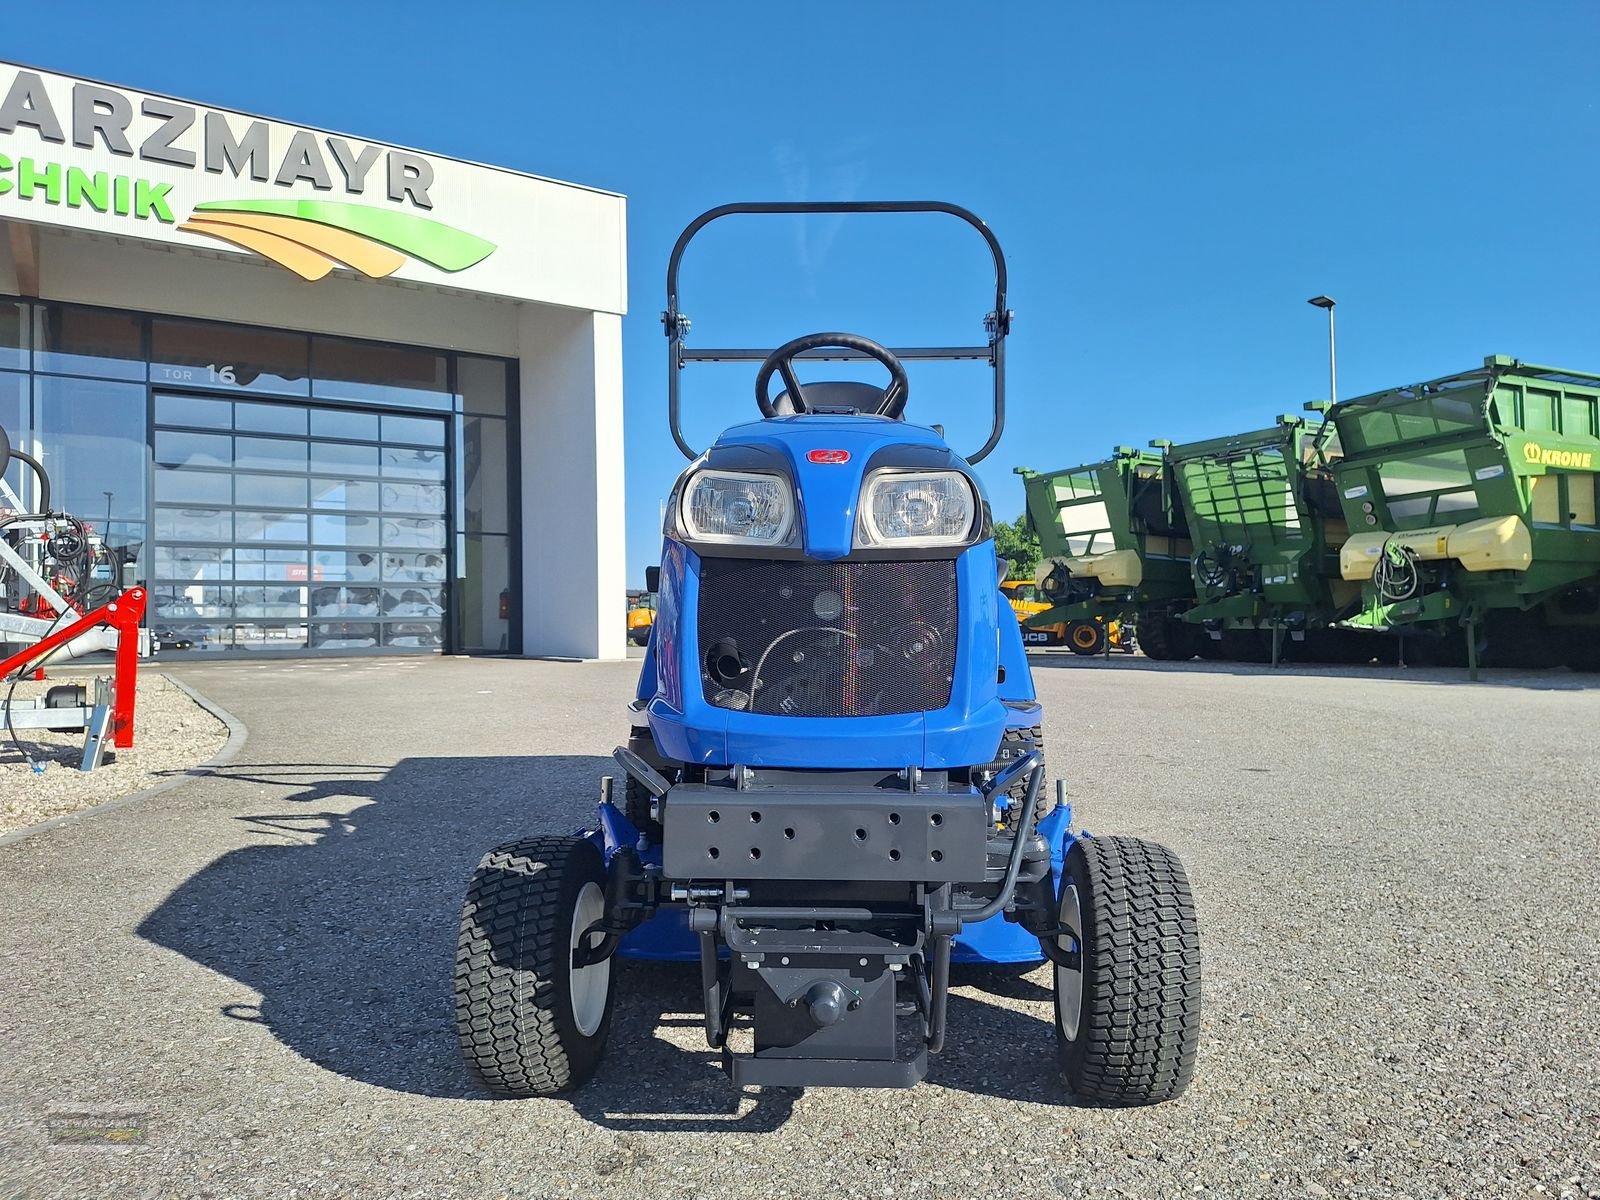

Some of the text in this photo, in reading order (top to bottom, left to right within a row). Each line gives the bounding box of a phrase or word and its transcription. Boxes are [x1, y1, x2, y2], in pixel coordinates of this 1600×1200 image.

[162, 363, 236, 385] TOR 16
[1540, 448, 1592, 468] KRONE
[1023, 632, 1048, 642] JCB
